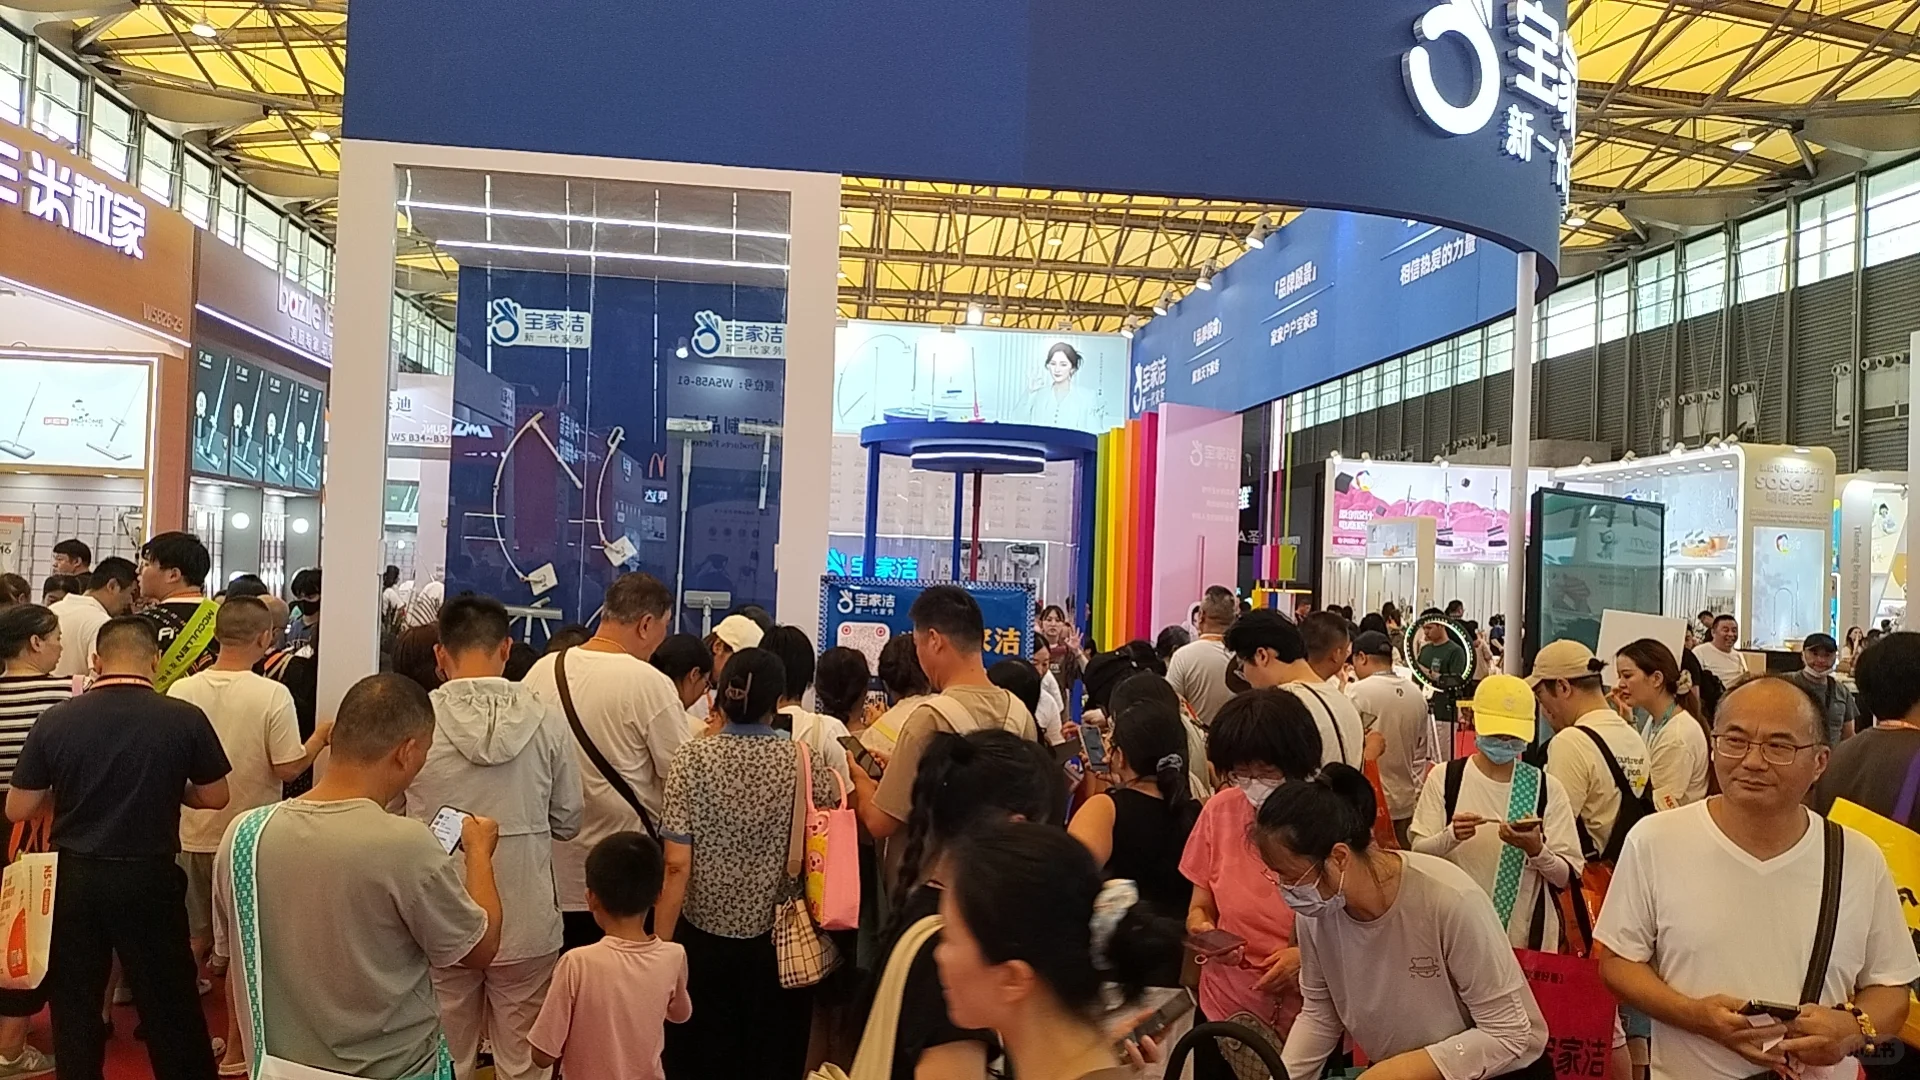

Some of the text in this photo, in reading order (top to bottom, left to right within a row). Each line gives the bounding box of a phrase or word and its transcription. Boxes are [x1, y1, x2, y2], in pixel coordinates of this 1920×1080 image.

[1400, 232, 1478, 286] 相信热爱的力量
[524, 312, 585, 332] 宝家洁
[726, 324, 784, 344] 宝家洁
[1142, 354, 1167, 394] 宝家洁
[855, 592, 896, 608] 宝家洁
[175, 609, 215, 663] MCCULLEN
